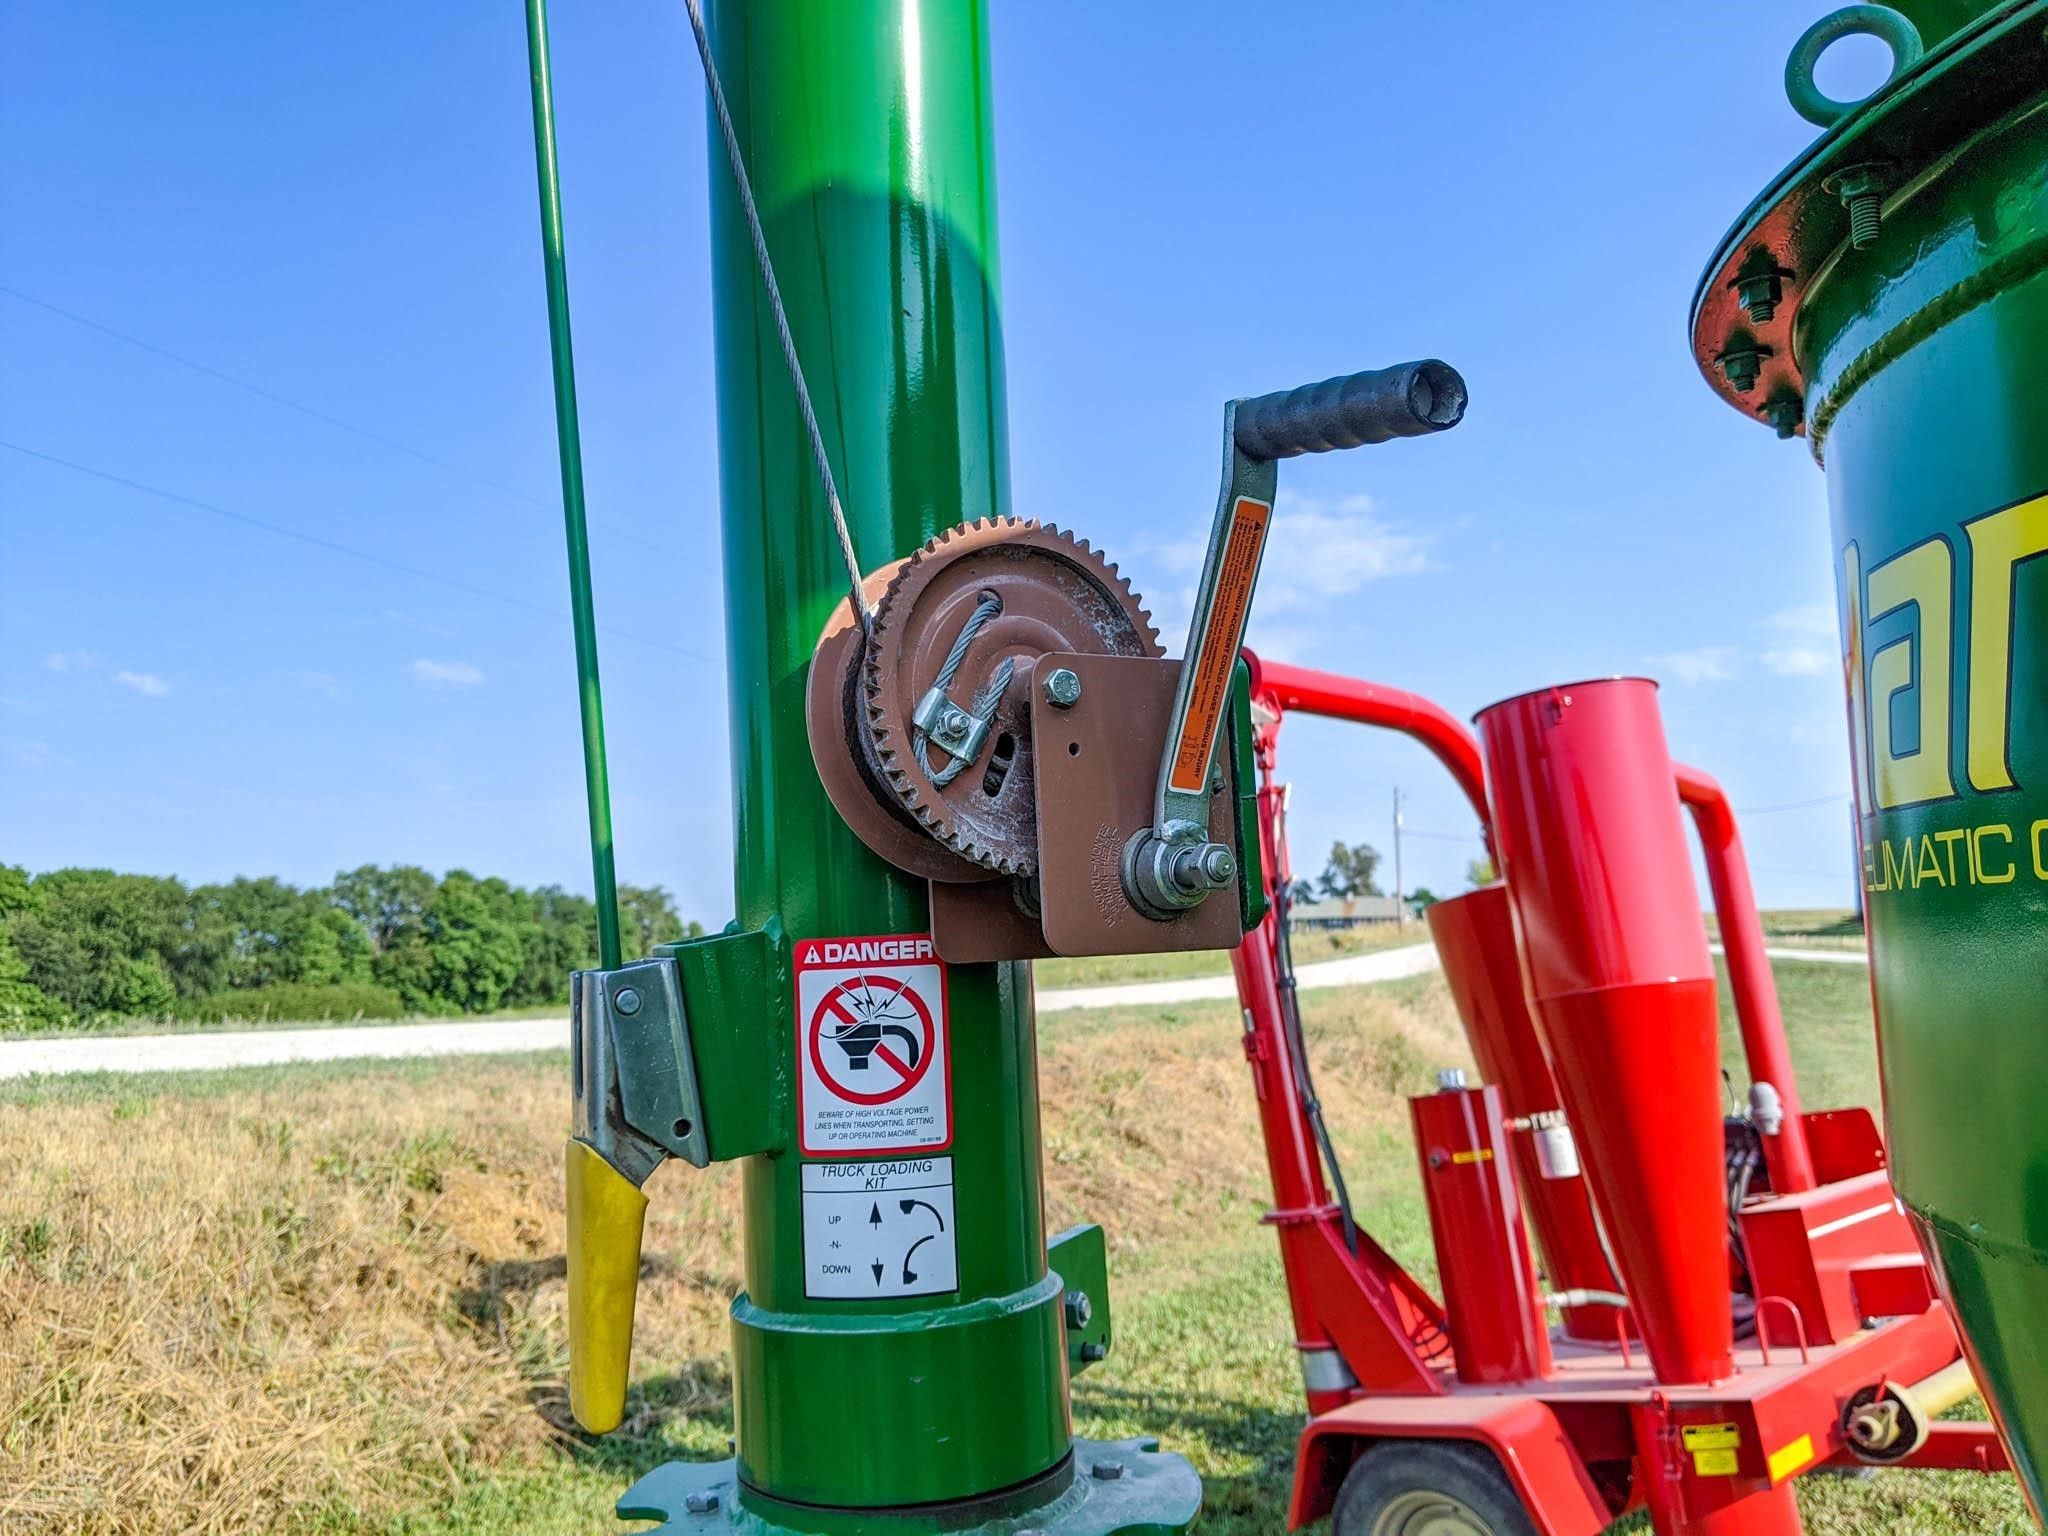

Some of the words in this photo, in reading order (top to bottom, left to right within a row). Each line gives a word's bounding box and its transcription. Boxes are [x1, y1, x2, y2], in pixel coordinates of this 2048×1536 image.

[1236, 584, 1245, 608] WINCH
[1224, 611, 1238, 652] ACCIDENT
[1217, 654, 1227, 682] COULD
[1210, 685, 1220, 711] CAUSE
[1201, 713, 1214, 747] SERIOUS
[1194, 748, 1205, 778] INJURY
[824, 940, 933, 963] DANGER
[818, 1110, 844, 1119] BEWARE
[845, 1110, 854, 1118] OF
[855, 1109, 872, 1118] HIGH
[873, 1108, 903, 1116] VOLTAGE
[904, 1106, 929, 1115] POWER
[814, 1122, 832, 1130] LINES
[833, 1121, 852, 1129] WHEN
[853, 1118, 905, 1129] TRANSPORTING,
[906, 1117, 934, 1126] SETTING
[838, 1132, 848, 1140] OR
[849, 1131, 886, 1139] OPERATING
[821, 1164, 866, 1178] TRUCK
[871, 1160, 933, 1175] LOADING
[865, 1177, 888, 1189] KIT
[828, 1216, 842, 1224] UP
[829, 1241, 842, 1249] -N-
[822, 1265, 851, 1274] DOWN
